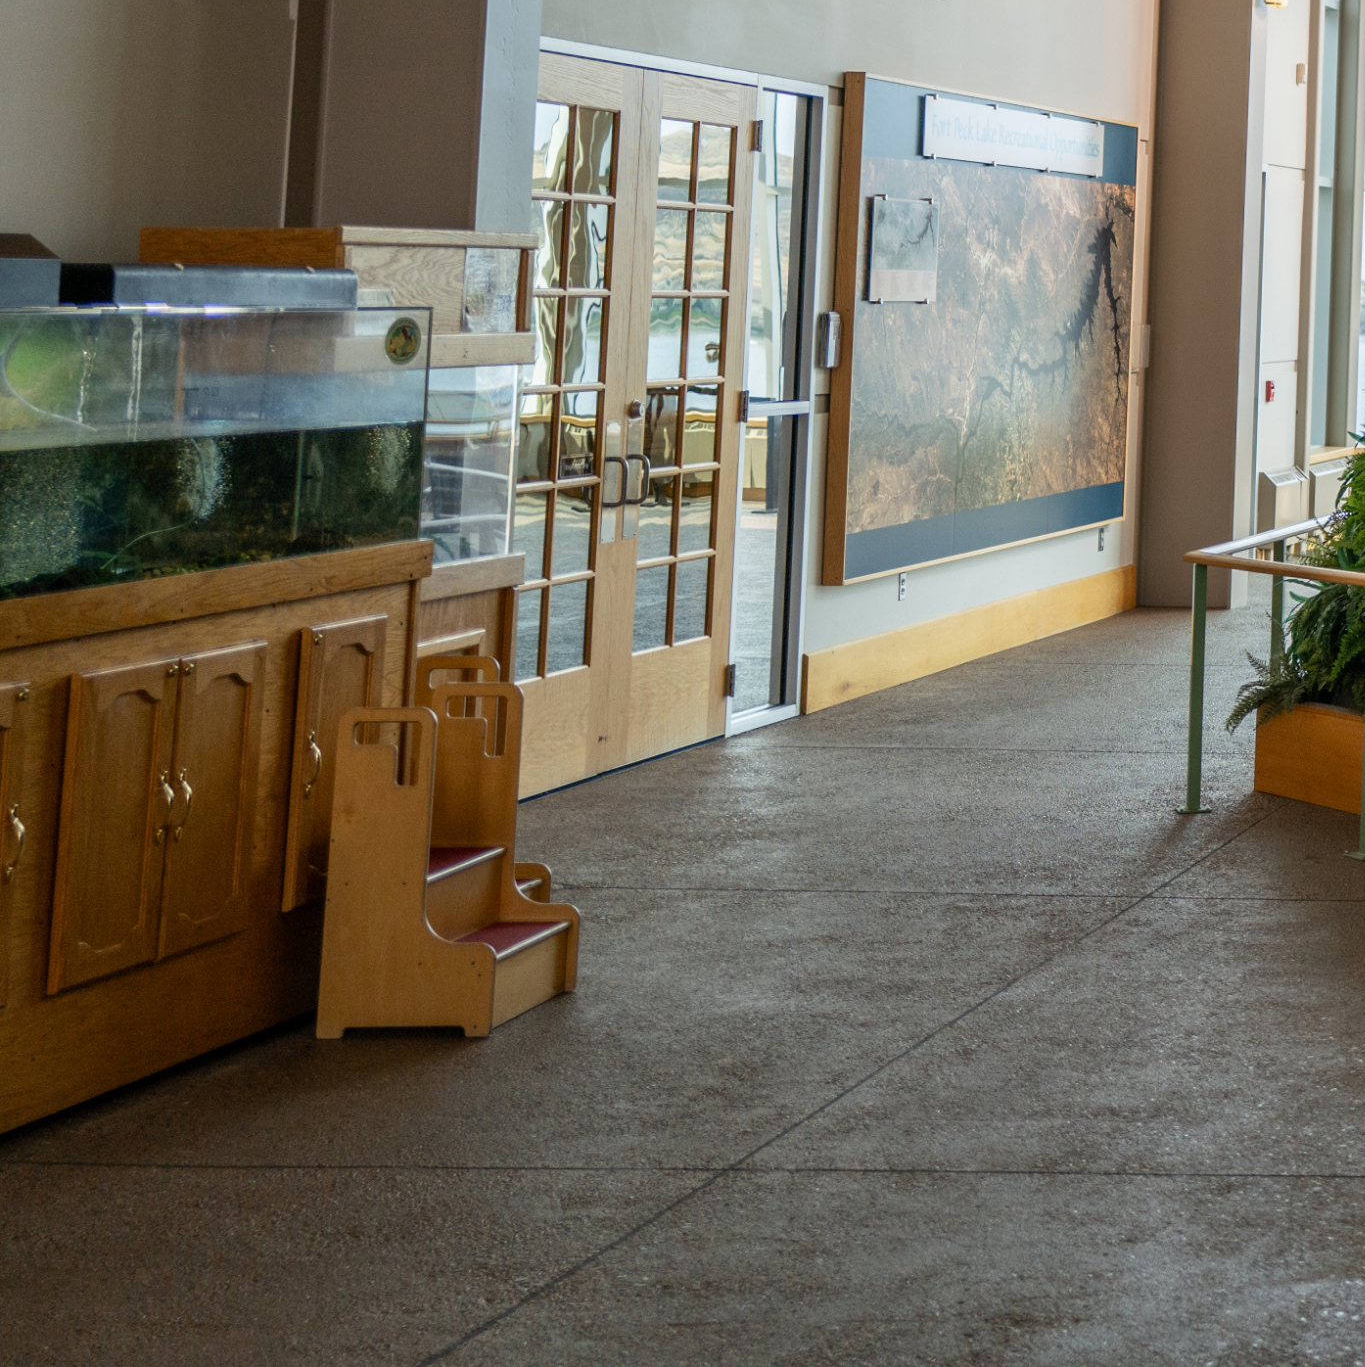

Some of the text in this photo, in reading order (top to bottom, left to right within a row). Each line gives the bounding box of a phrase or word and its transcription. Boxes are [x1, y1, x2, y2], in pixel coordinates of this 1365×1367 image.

[932, 114, 1100, 161] Fort Peck Lake Recreational Opportunities
